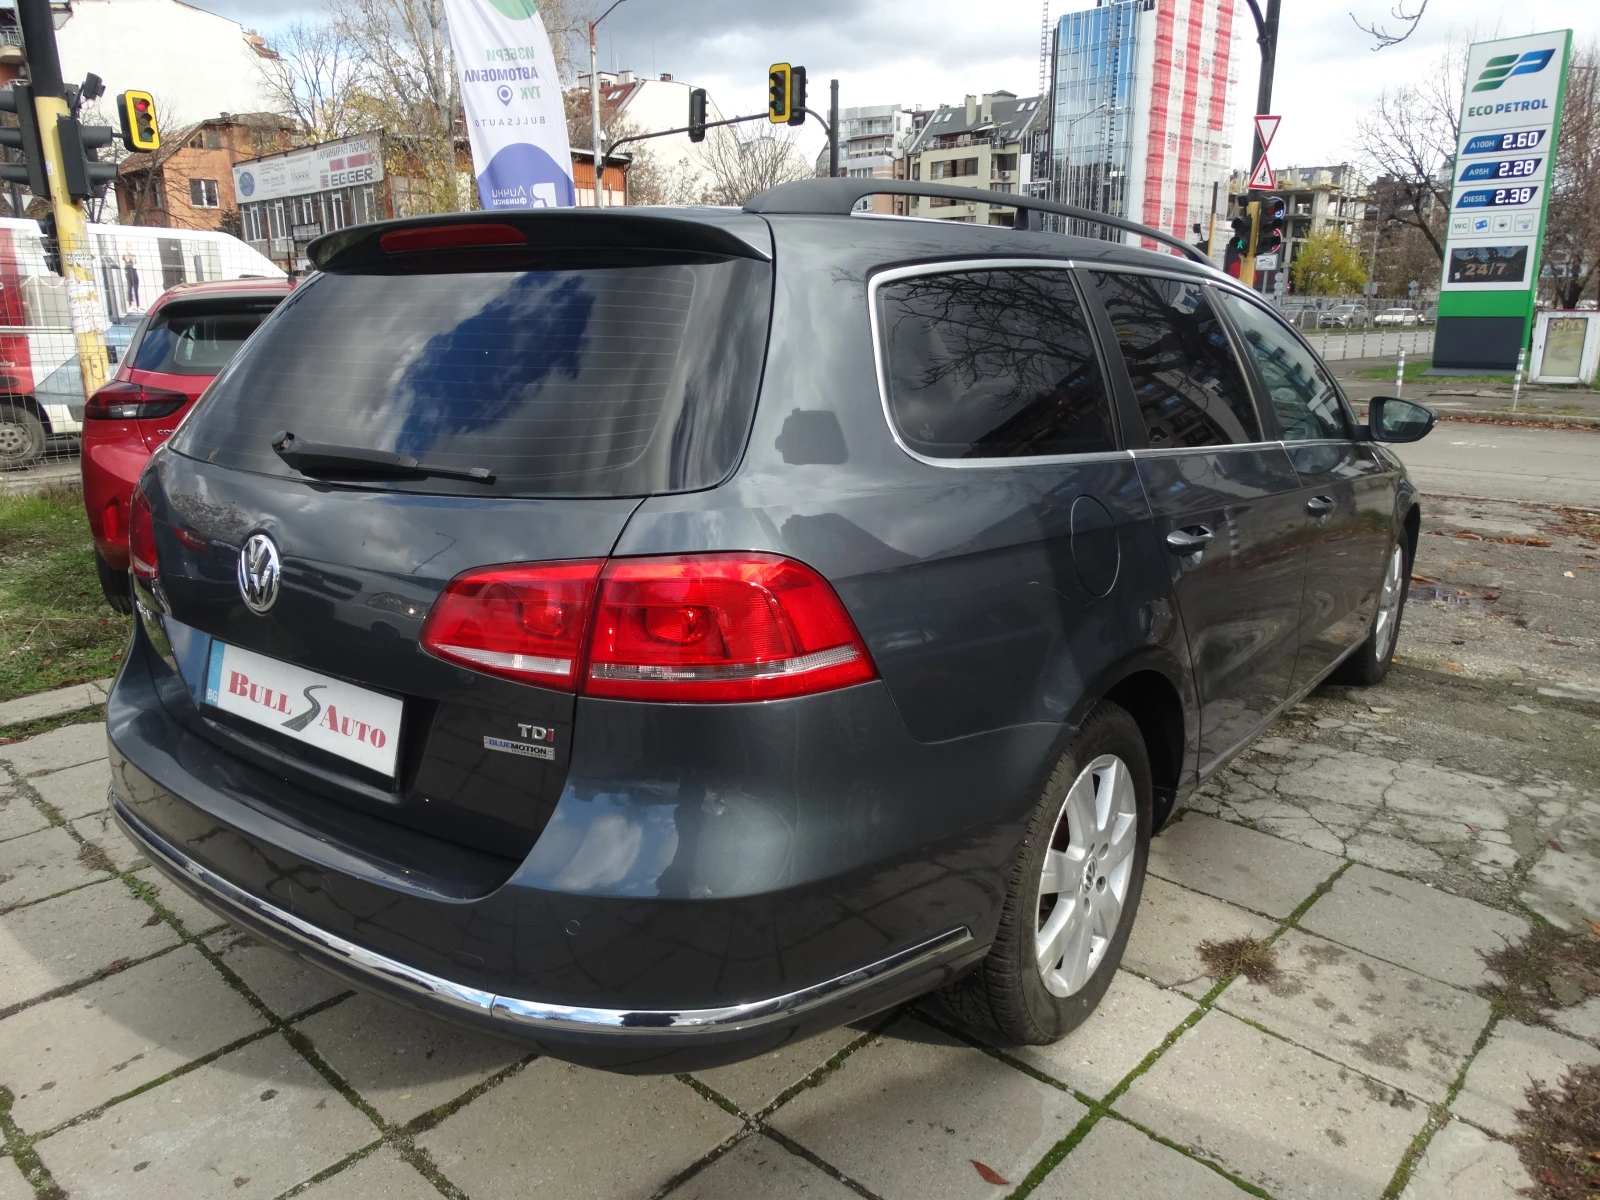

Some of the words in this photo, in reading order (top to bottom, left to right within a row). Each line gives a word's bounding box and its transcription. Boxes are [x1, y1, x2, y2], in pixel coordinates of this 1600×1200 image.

[1468, 104, 1493, 117] ECO
[1495, 98, 1548, 114] PETROL
[1470, 140, 1495, 149] A100H
[1502, 131, 1539, 149] 2.60
[330, 167, 373, 187] EGGER
[1468, 168, 1489, 176] A95H
[1498, 160, 1535, 177] 2.28
[1463, 195, 1487, 203] DIESEL
[1495, 188, 1531, 204] 2.38
[1454, 222, 1468, 230] WC
[1464, 262, 1507, 277] 24/7
[207, 688, 218, 702] BG
[517, 723, 554, 743] TDI
[488, 738, 547, 756] BLUEMOTION
